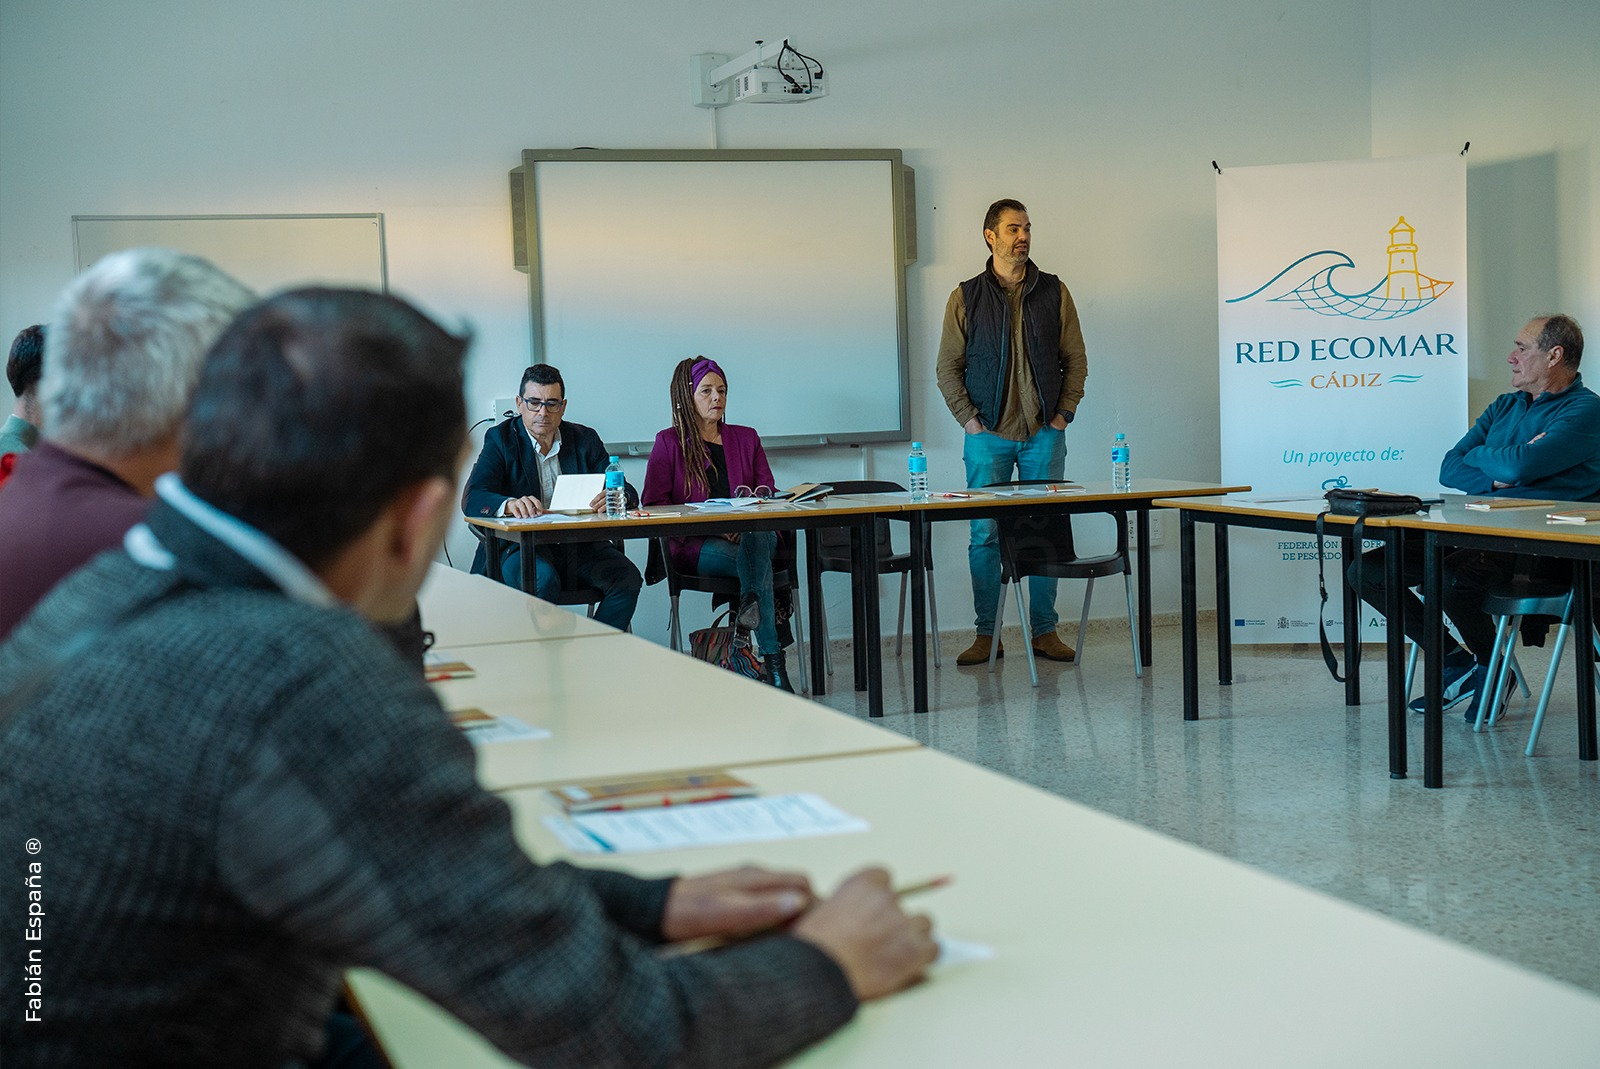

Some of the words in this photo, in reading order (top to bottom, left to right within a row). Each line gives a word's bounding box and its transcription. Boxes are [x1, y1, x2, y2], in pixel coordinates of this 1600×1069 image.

[1236, 340, 1300, 364] RED
[1310, 333, 1459, 361] ECOMAR
[1310, 371, 1382, 389] CÁDIZ
[1282, 449, 1304, 464] Un
[1308, 448, 1376, 467] proyecto
[1380, 446, 1405, 461] de:
[1278, 540, 1338, 550] FEDERACÓN
[1282, 552, 1296, 561] DE
